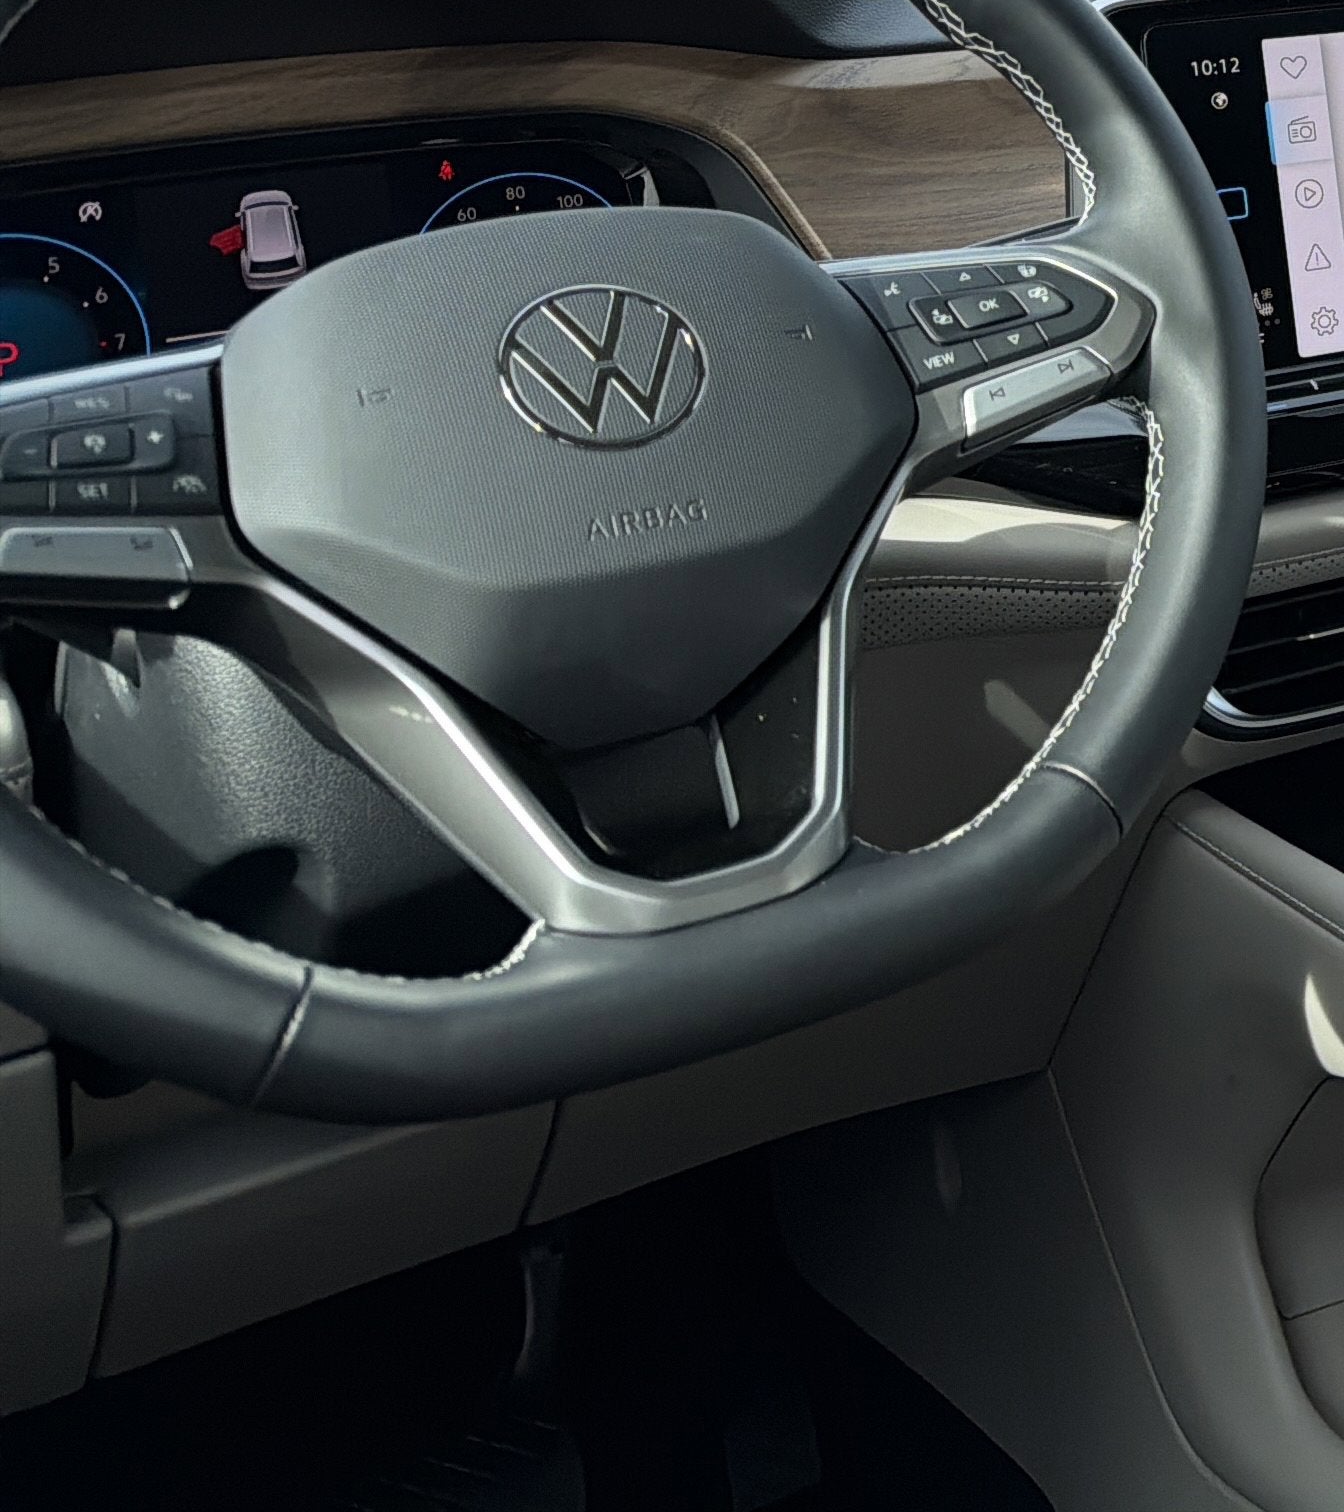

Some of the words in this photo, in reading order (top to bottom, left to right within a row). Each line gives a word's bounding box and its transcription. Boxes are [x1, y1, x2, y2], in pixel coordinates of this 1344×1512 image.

[1190, 57, 1241, 77] 10:12
[505, 185, 526, 201] 80
[556, 193, 584, 208] 100
[456, 206, 477, 222] 60
[48, 256, 60, 274] 5
[95, 286, 109, 304] 6
[978, 297, 1000, 312] OK
[114, 332, 126, 351] 7
[922, 351, 955, 371] VIEW
[587, 497, 708, 542] AIRBAG
